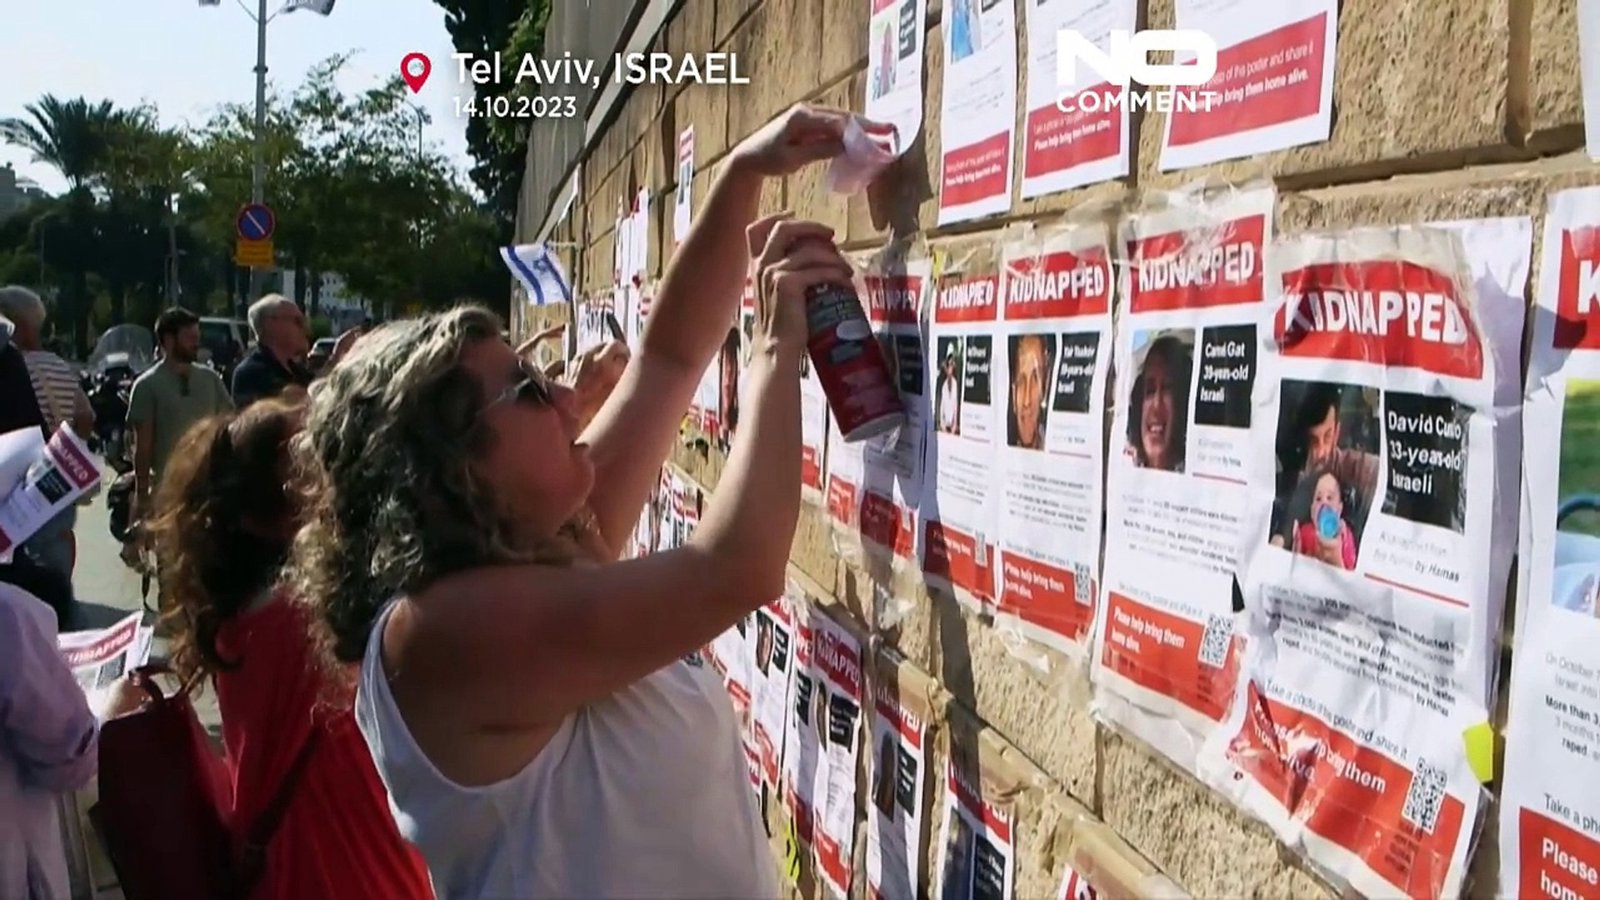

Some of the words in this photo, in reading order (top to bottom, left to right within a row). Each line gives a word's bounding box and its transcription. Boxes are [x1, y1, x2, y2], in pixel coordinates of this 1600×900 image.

[1269, 51, 1284, 67] and
[1285, 45, 1308, 63] share
[1225, 86, 1244, 103] bring
[1265, 73, 1286, 90] home
[1139, 240, 1255, 293] KIDNAPPED
[1009, 264, 1103, 304] KIDNAPPED
[1283, 284, 1469, 346] KIDNAPPED
[1227, 340, 1246, 358] Gat
[1388, 410, 1433, 435] David
[1163, 628, 1186, 649] them
[1545, 694, 1568, 713] More
[1569, 704, 1591, 721] than
[1346, 763, 1387, 795] them
[1544, 792, 1571, 819] Take
[1542, 836, 1598, 886] Please
